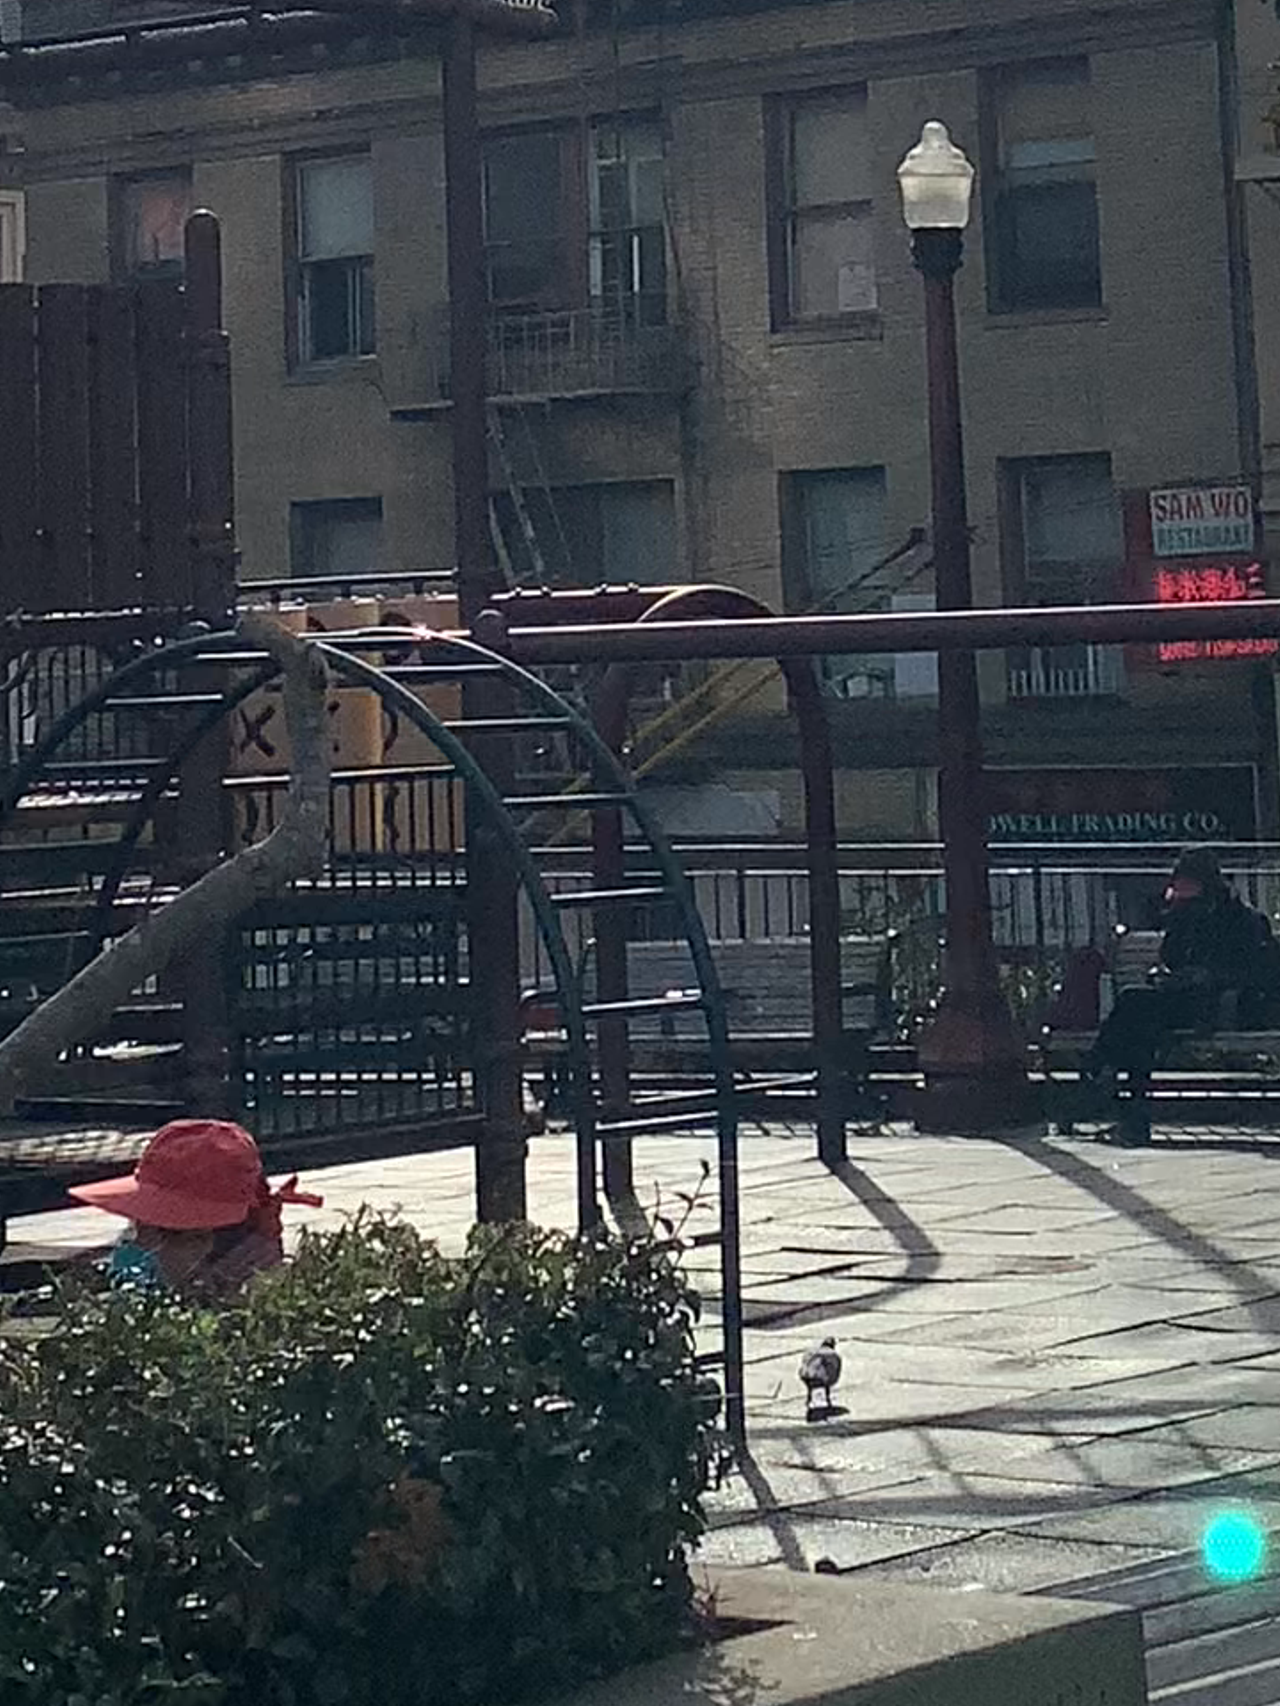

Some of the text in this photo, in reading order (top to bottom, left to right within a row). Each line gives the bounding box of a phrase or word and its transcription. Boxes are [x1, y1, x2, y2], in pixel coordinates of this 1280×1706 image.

[1154, 491, 1248, 522] SAM WO
[1157, 523, 1250, 551] RESTAURANT
